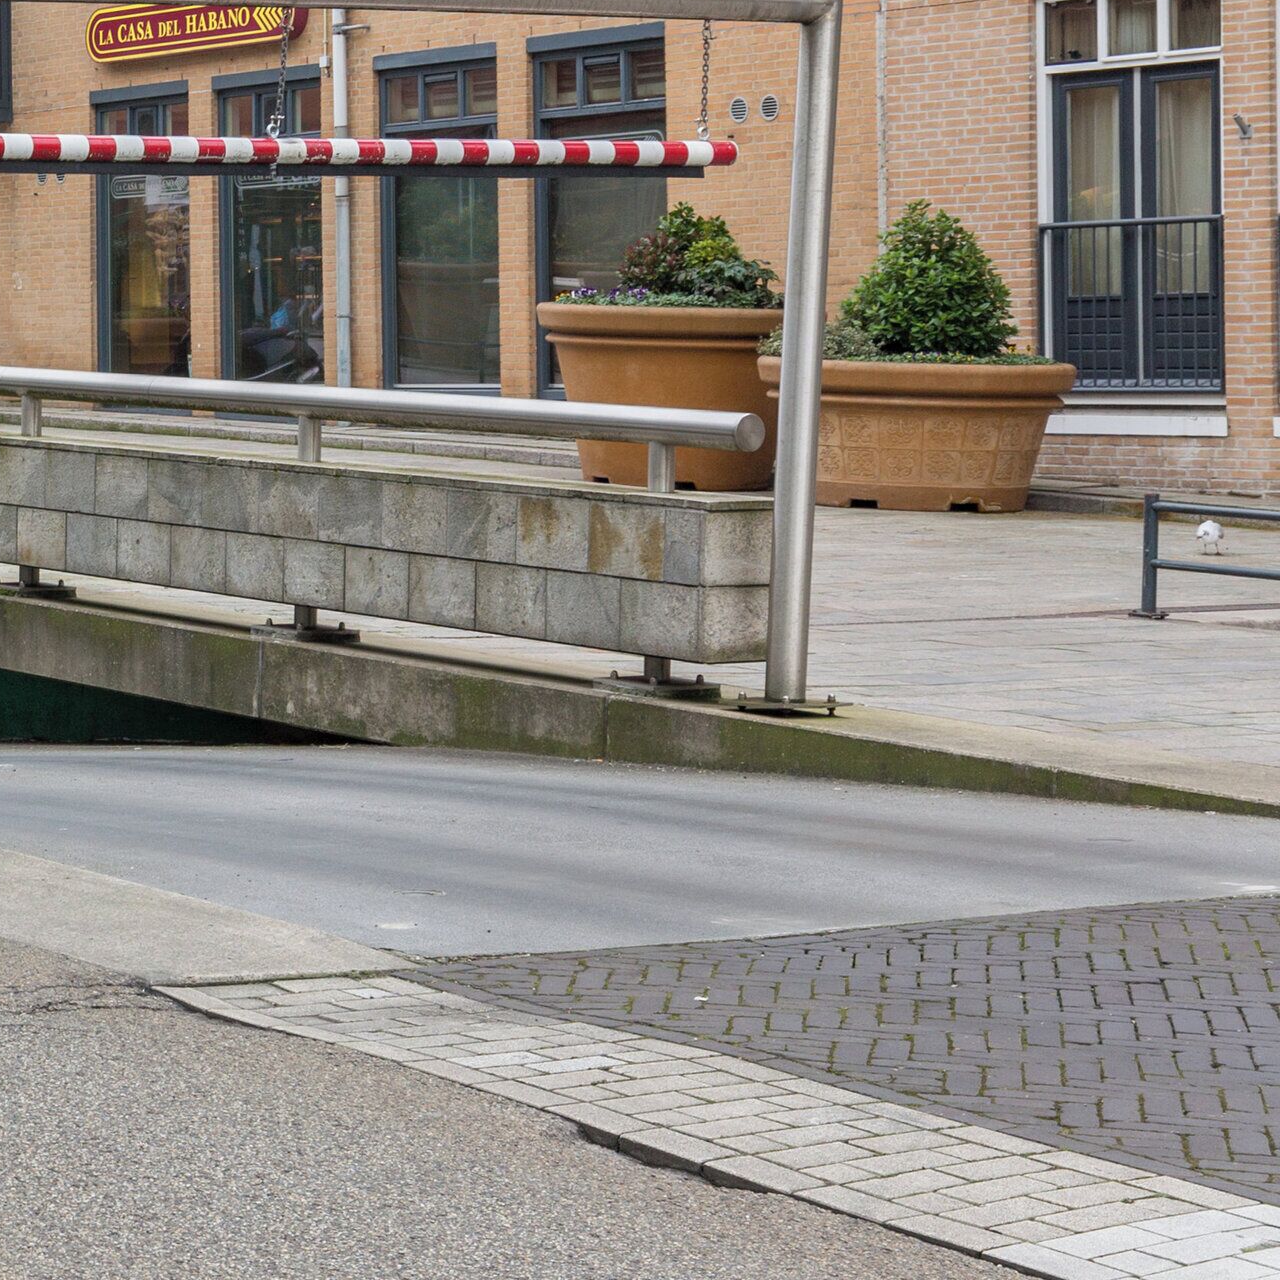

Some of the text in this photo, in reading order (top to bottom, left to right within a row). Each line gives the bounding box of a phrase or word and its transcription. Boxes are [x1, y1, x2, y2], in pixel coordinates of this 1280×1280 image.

[99, 7, 251, 46] LA CASA DEL HABANO
